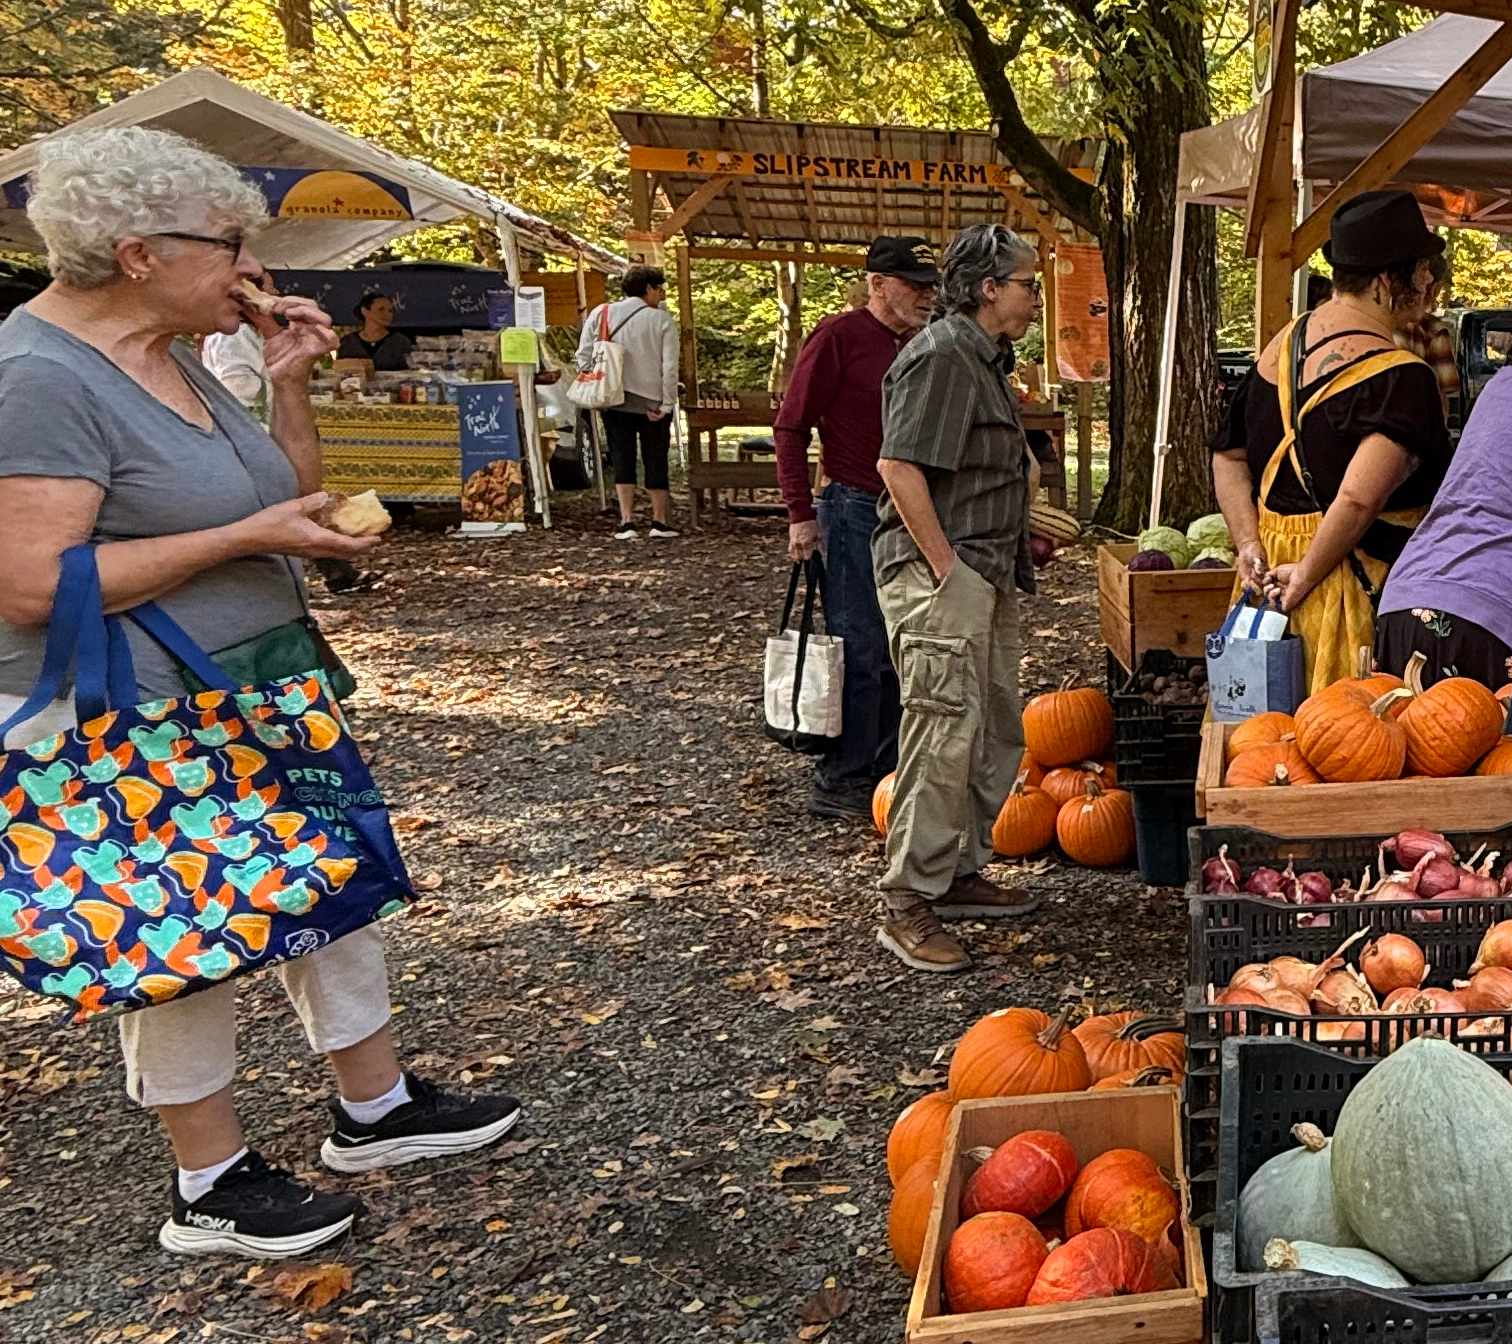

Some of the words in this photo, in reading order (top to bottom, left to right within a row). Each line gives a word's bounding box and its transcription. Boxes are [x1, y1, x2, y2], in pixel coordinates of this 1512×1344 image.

[753, 153, 912, 179] SLIPSTREAM
[923, 161, 988, 184] FARM
[286, 205, 340, 216] granola
[347, 208, 403, 218] company
[286, 767, 343, 788] PETS
[185, 1210, 237, 1233] HOKA
